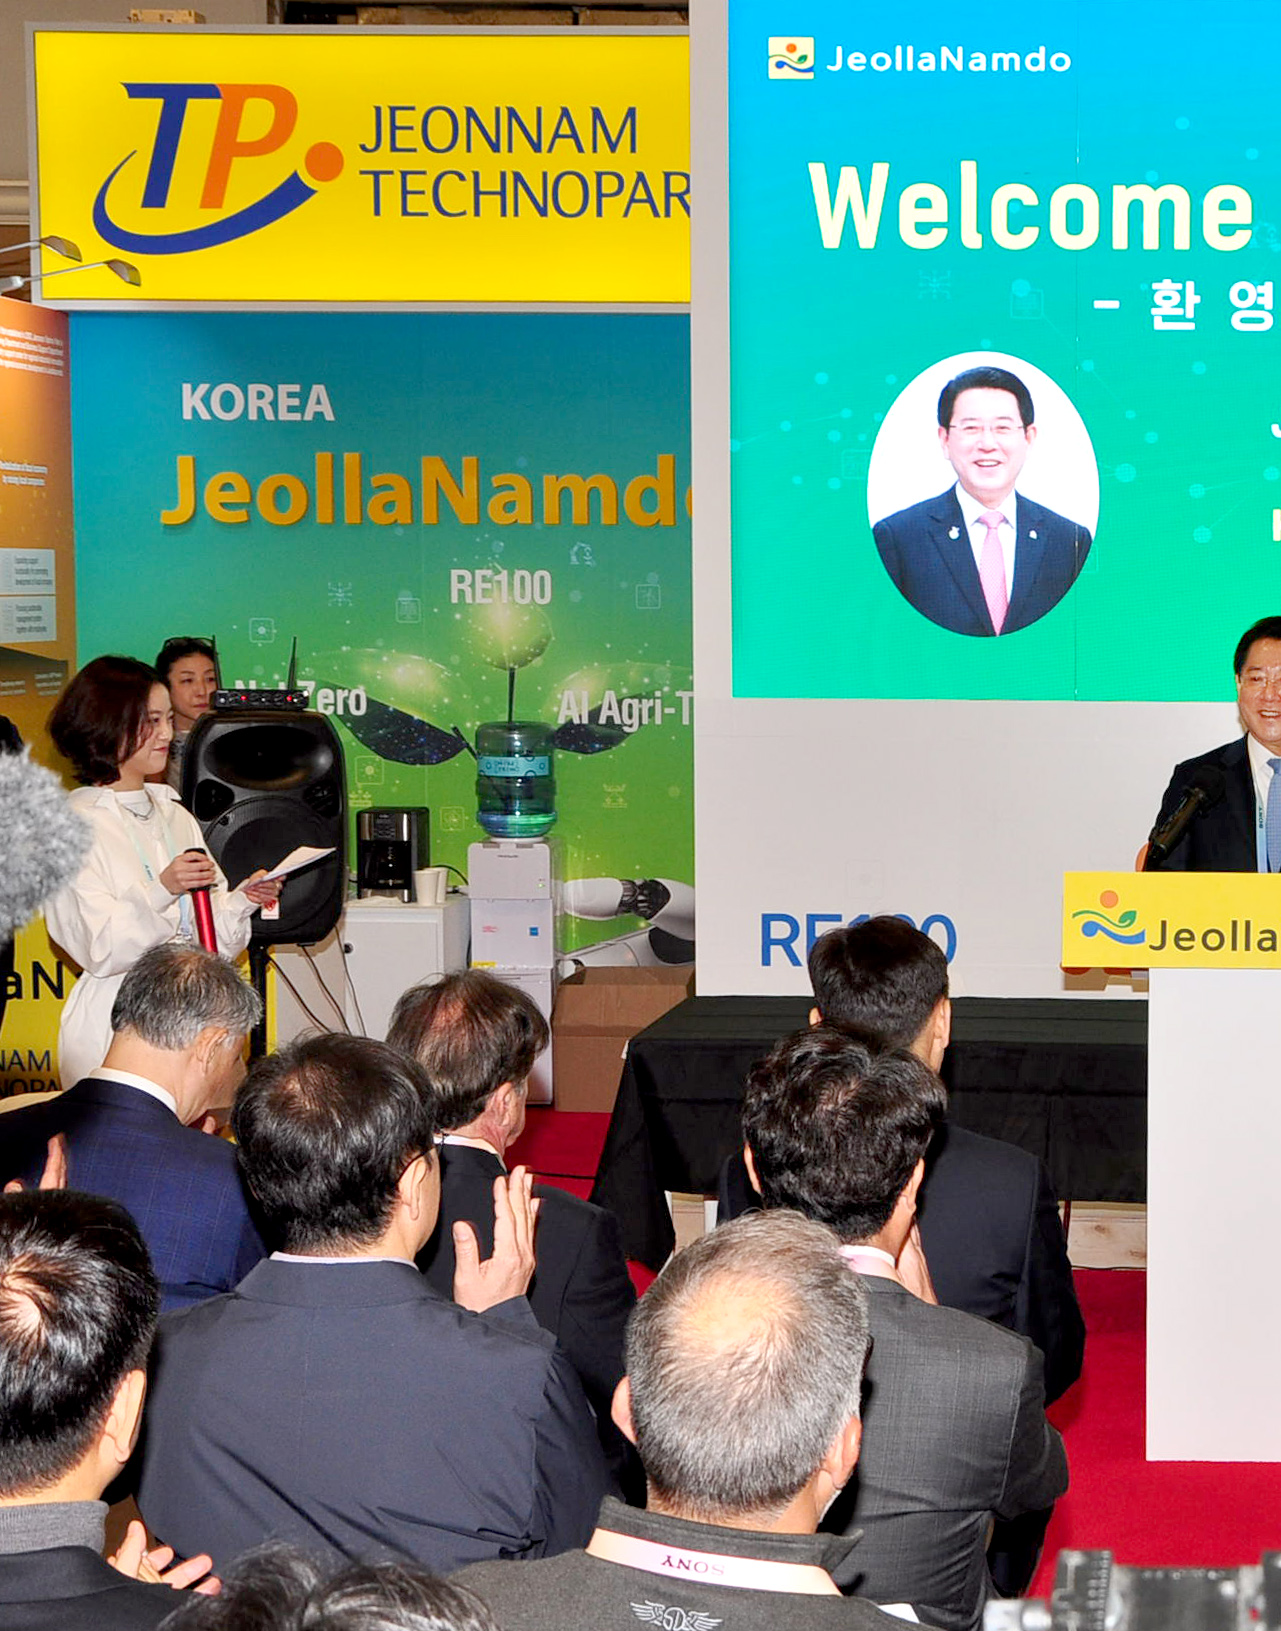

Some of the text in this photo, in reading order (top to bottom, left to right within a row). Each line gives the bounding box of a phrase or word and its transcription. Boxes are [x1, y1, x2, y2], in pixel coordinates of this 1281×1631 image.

[827, 45, 1072, 73] JeollaNamdo
[121, 83, 298, 208] TP
[359, 106, 637, 154] JEONNAM
[808, 160, 1253, 251] Welcome
[182, 384, 335, 422] KOREA
[161, 452, 692, 526] JeollaNamd
[449, 569, 553, 606] RE100
[557, 690, 589, 725] AI
[761, 913, 957, 967] RE0
[661, 1555, 726, 1576] SONY
